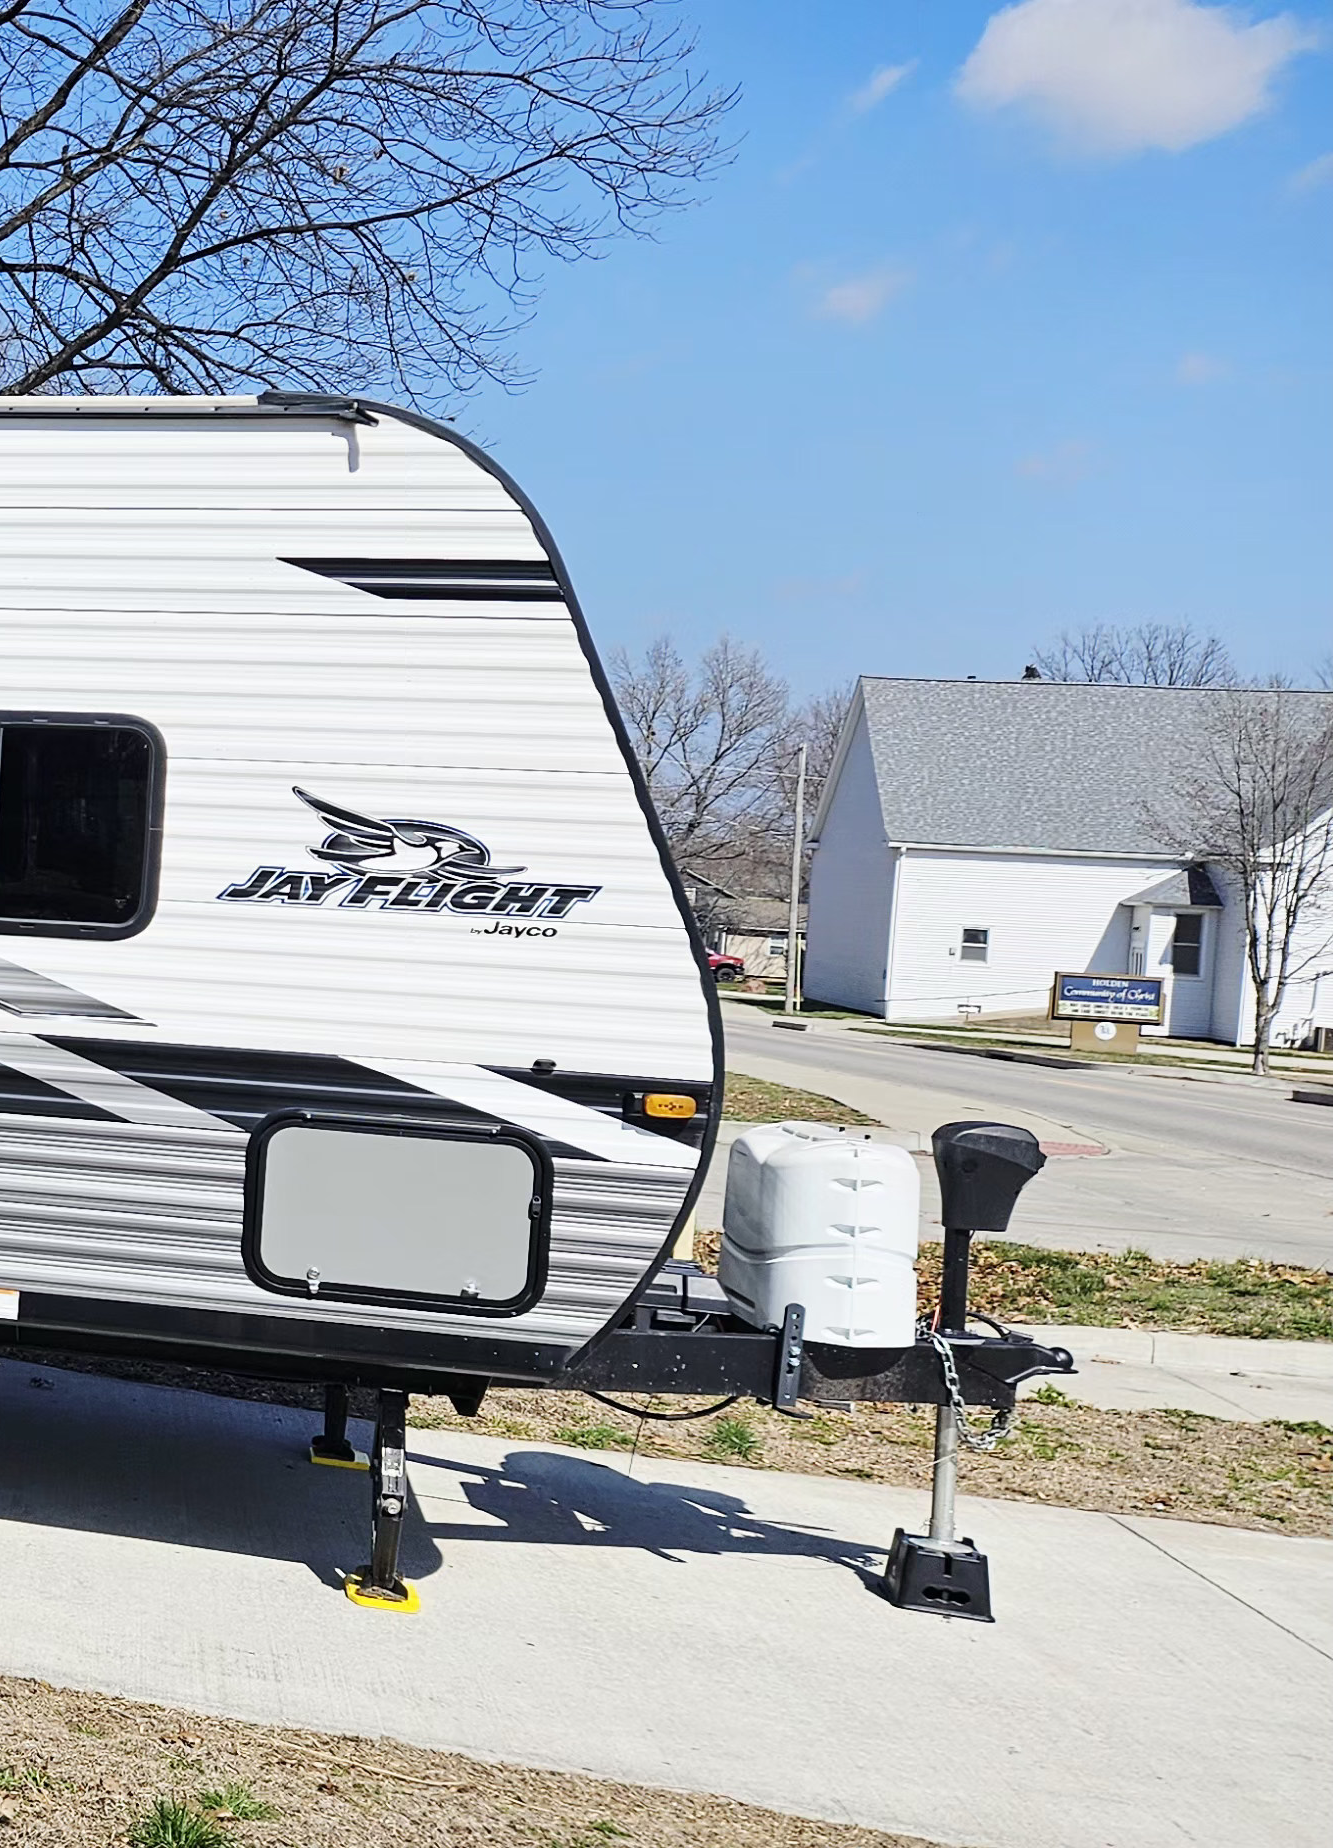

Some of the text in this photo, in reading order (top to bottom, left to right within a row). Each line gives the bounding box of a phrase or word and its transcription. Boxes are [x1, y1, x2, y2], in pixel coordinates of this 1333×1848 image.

[218, 865, 604, 919] JAY FLIGHT
[483, 921, 558, 938] Jayco
[1092, 979, 1129, 988] HOLDEN
[1063, 986, 1156, 1003] Community of Christ
